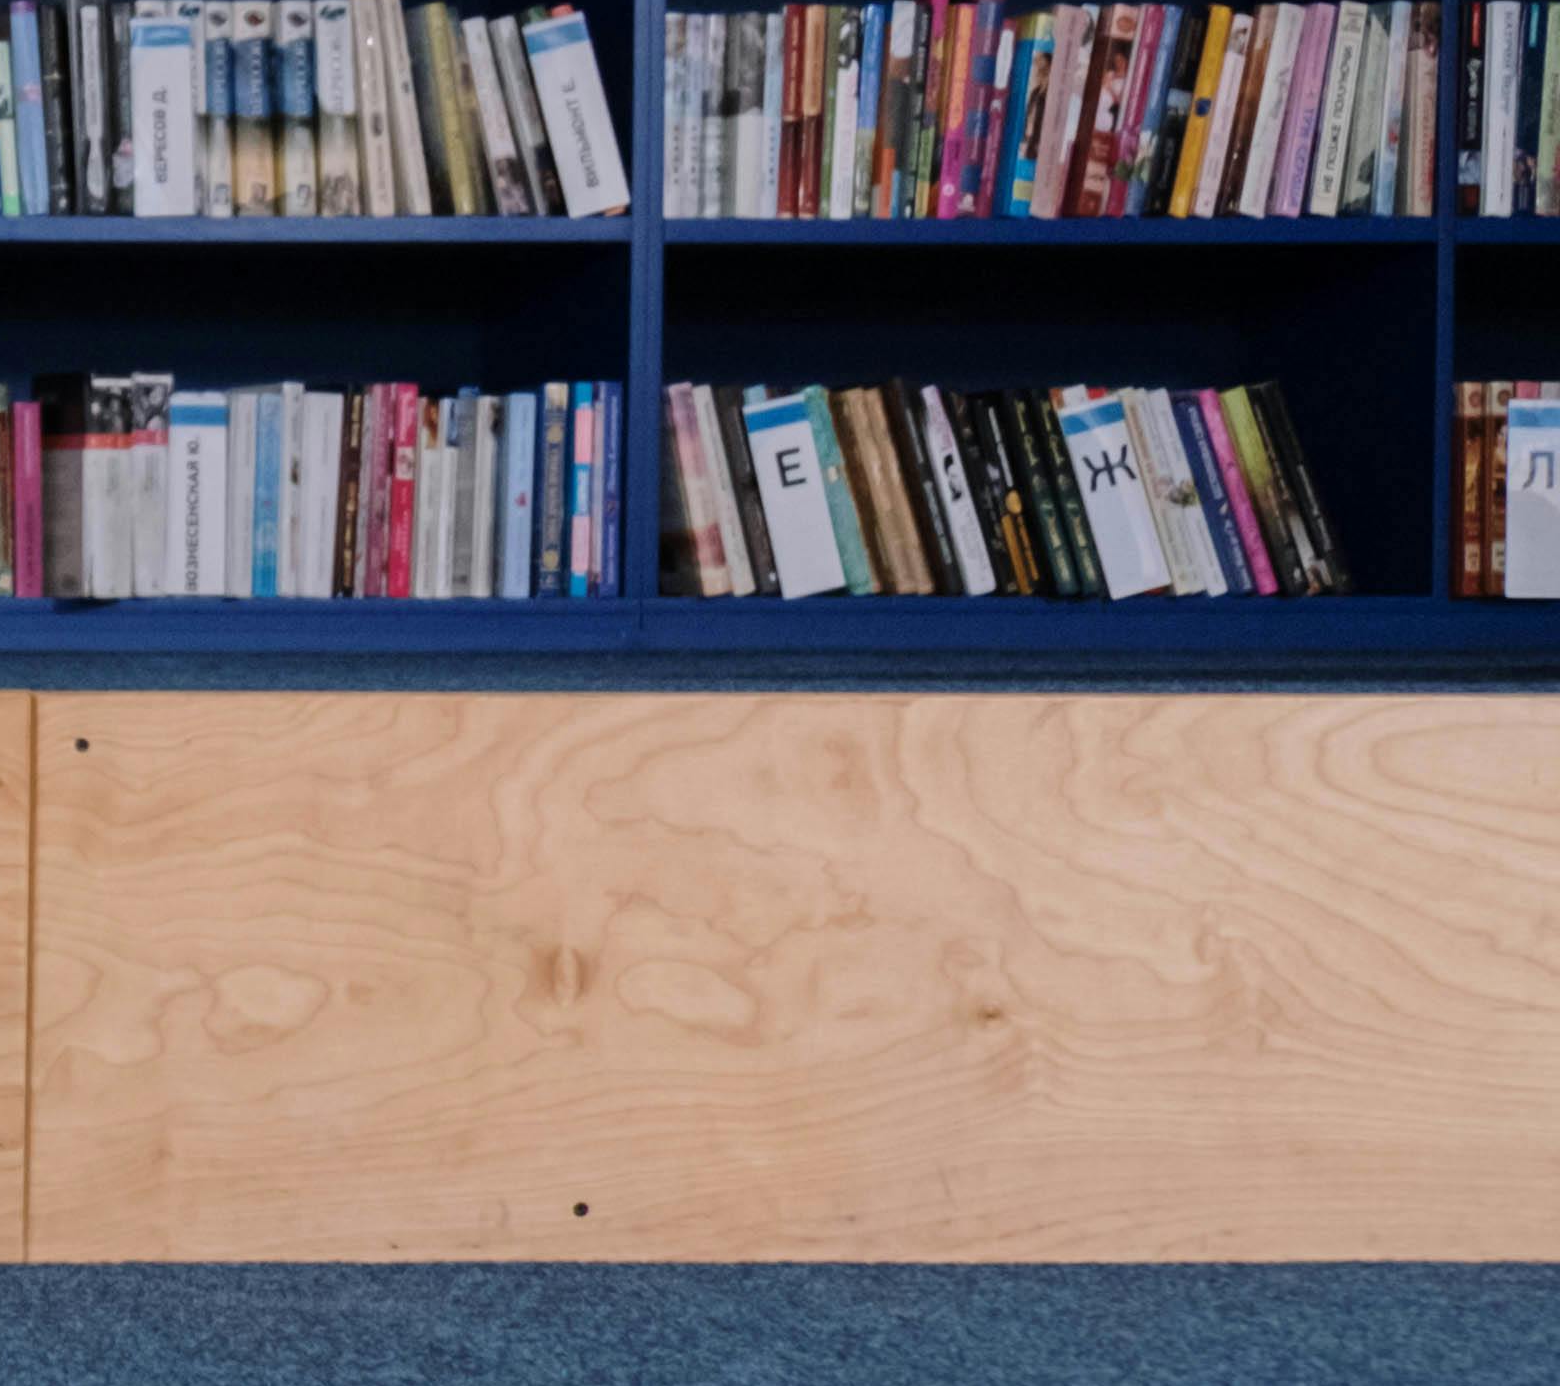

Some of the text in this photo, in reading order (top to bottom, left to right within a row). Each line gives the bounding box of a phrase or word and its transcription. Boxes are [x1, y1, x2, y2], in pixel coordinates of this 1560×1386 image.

[1328, 43, 1353, 119] ПОЛУНОЧИ
[152, 107, 169, 186] ВЕРЕСОВ
[567, 98, 601, 188] ВИЛЬМОНТ
[775, 447, 807, 489] Е
[1081, 443, 1138, 489] Ж
[1522, 454, 1556, 491] Л
[184, 458, 201, 593] ВОЗНЕСЕНСКАЯ
